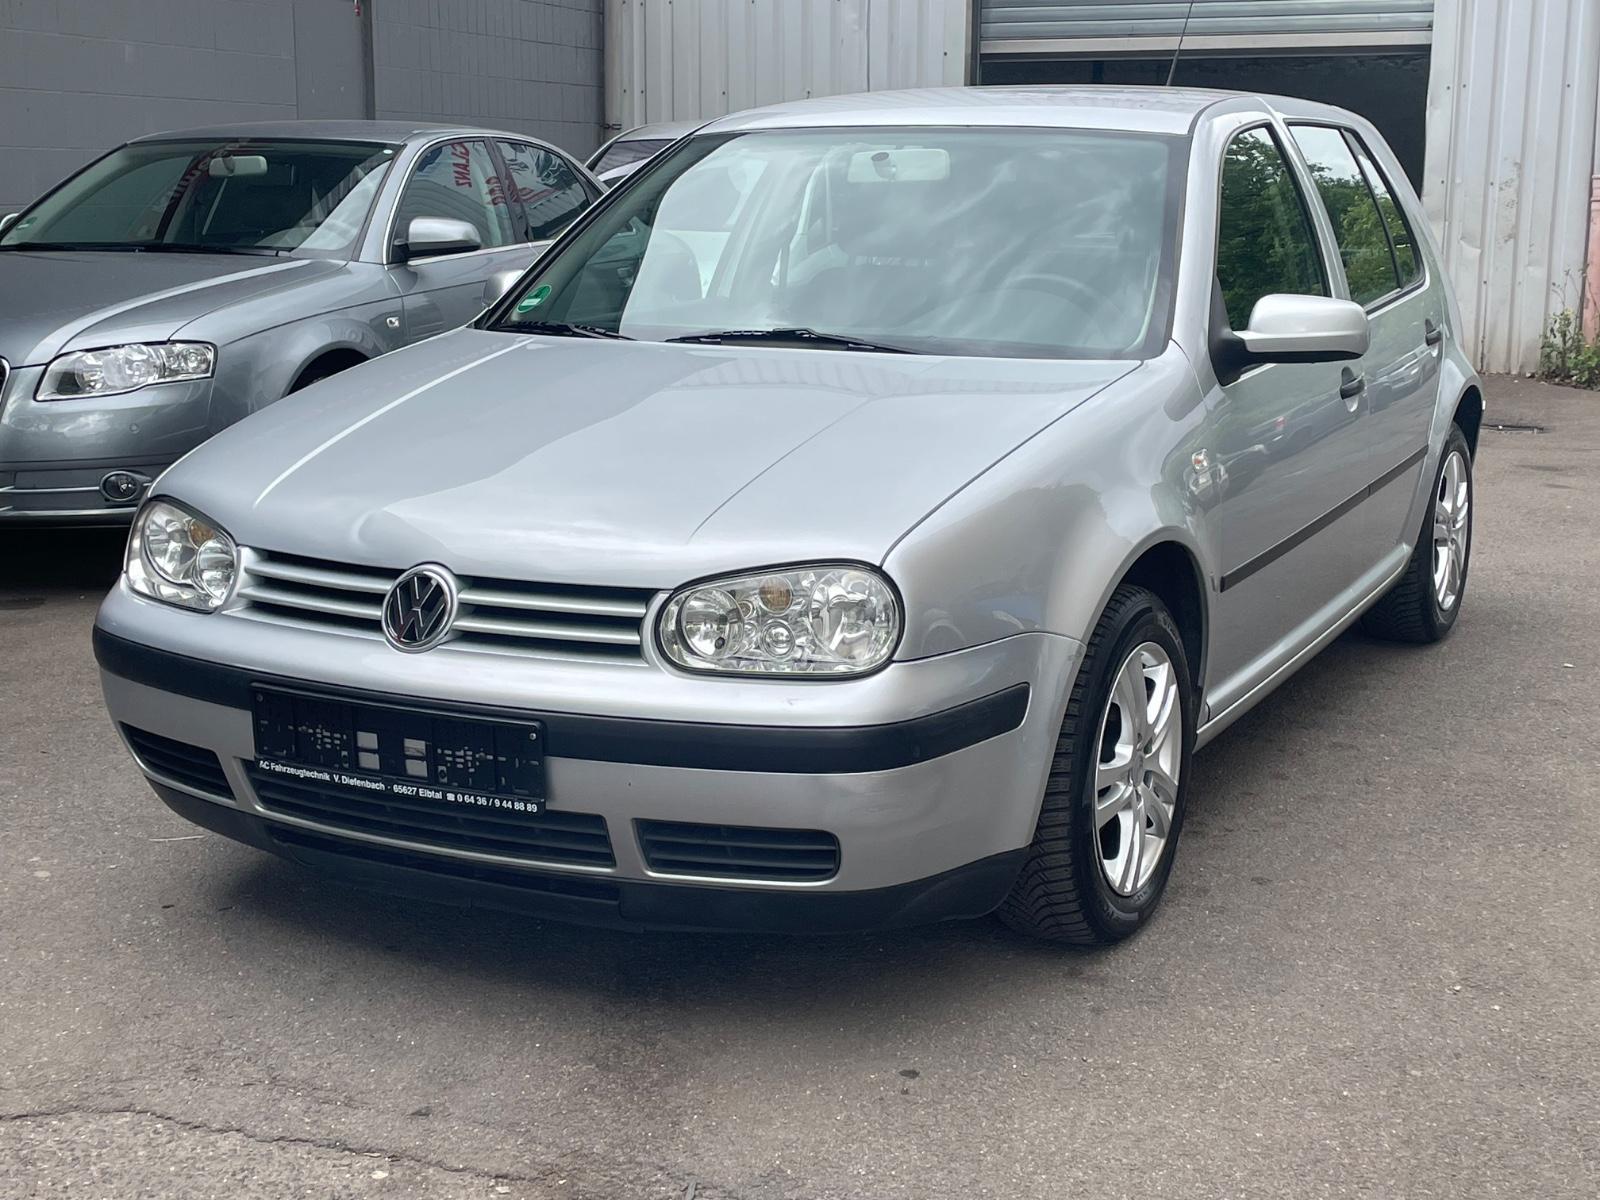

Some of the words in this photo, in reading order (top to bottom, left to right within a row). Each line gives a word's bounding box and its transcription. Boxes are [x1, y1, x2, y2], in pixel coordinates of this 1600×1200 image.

[386, 568, 452, 646] VW
[259, 760, 270, 770] AC
[270, 762, 331, 781] Fahrzeugtechnik
[333, 774, 341, 783] V.
[341, 775, 386, 791] Diefenbach
[392, 784, 417, 796] 65627
[418, 788, 443, 800] Elbtal
[464, 794, 475, 804] 64
[501, 800, 513, 809] 44
[514, 801, 525, 811] 88
[526, 803, 538, 813] 89
